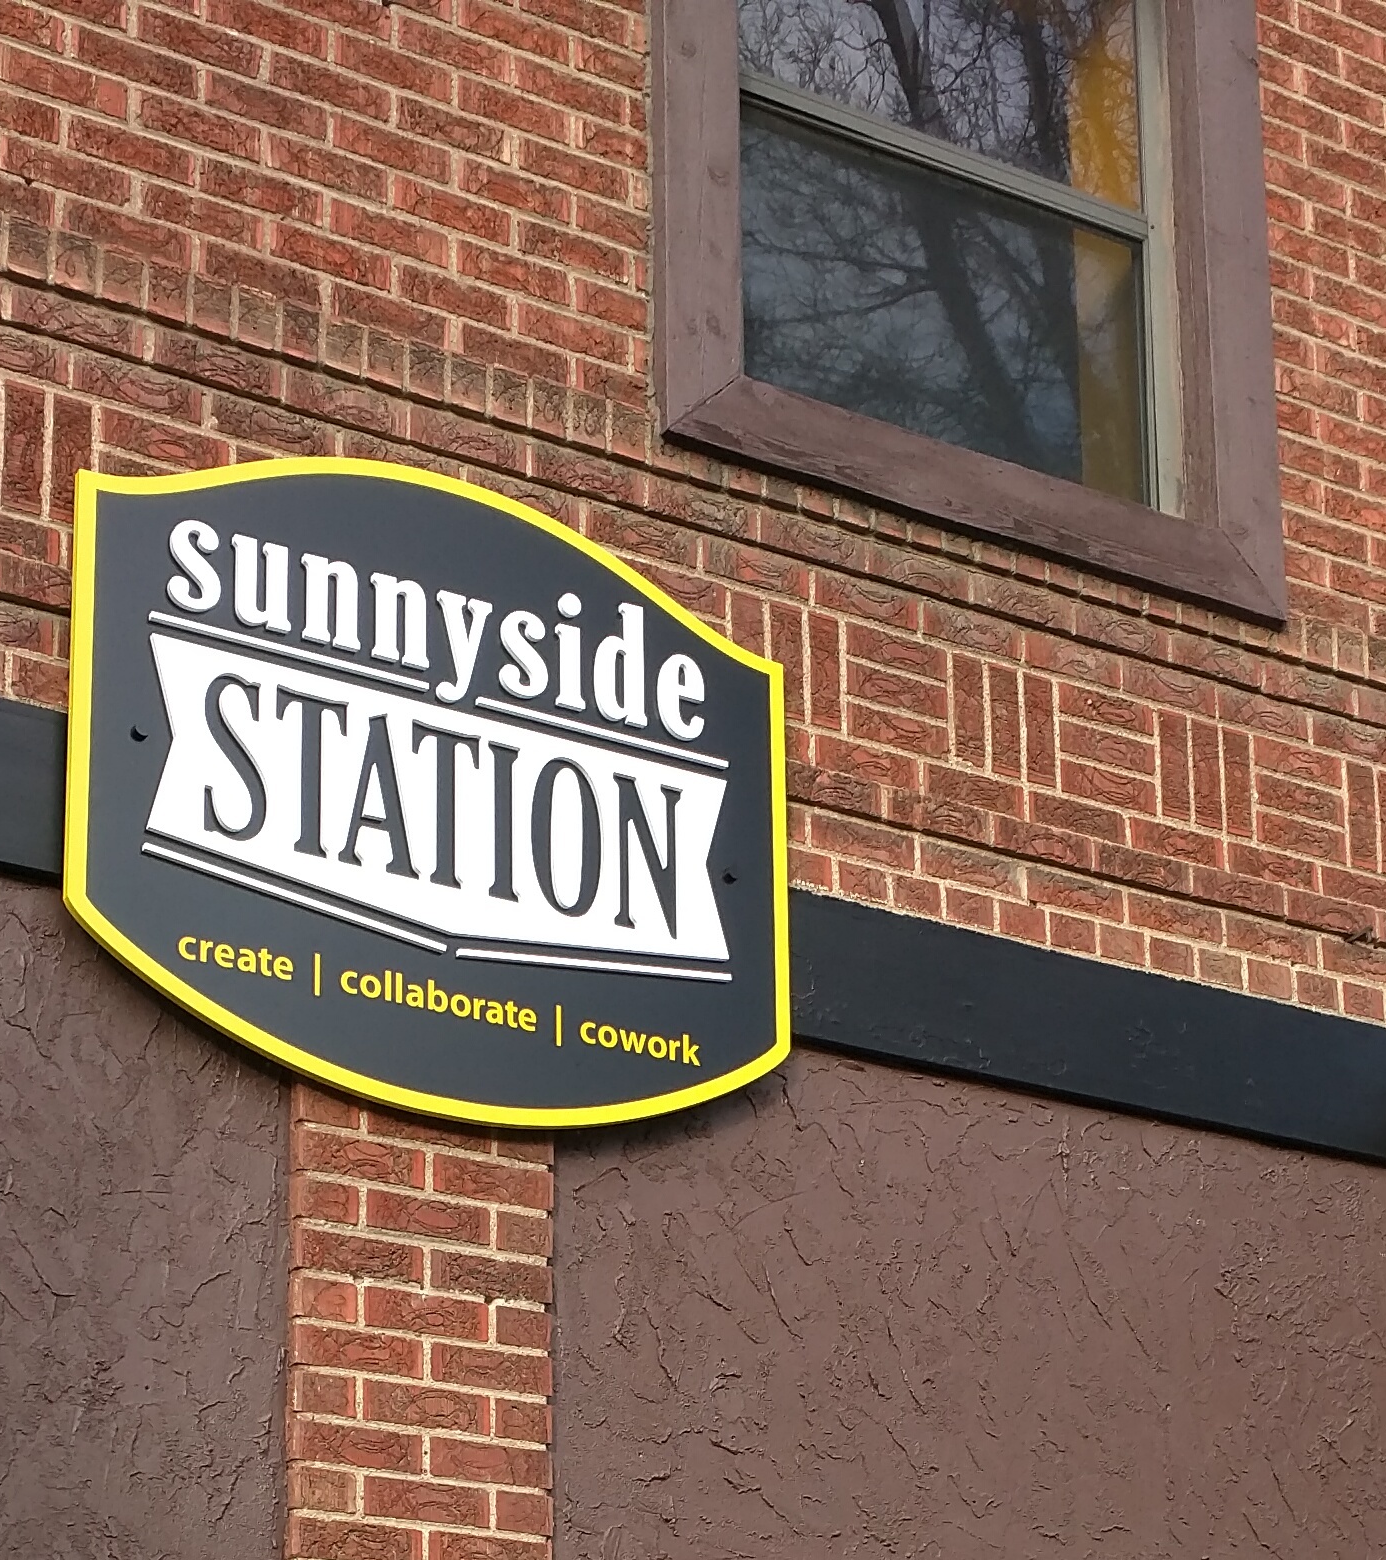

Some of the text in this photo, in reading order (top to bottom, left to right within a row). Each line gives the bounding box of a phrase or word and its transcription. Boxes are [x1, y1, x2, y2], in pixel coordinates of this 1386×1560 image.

[165, 519, 707, 740] sunnyside
[203, 671, 683, 939] STATION
[177, 935, 701, 1066] create collaborate cowork
